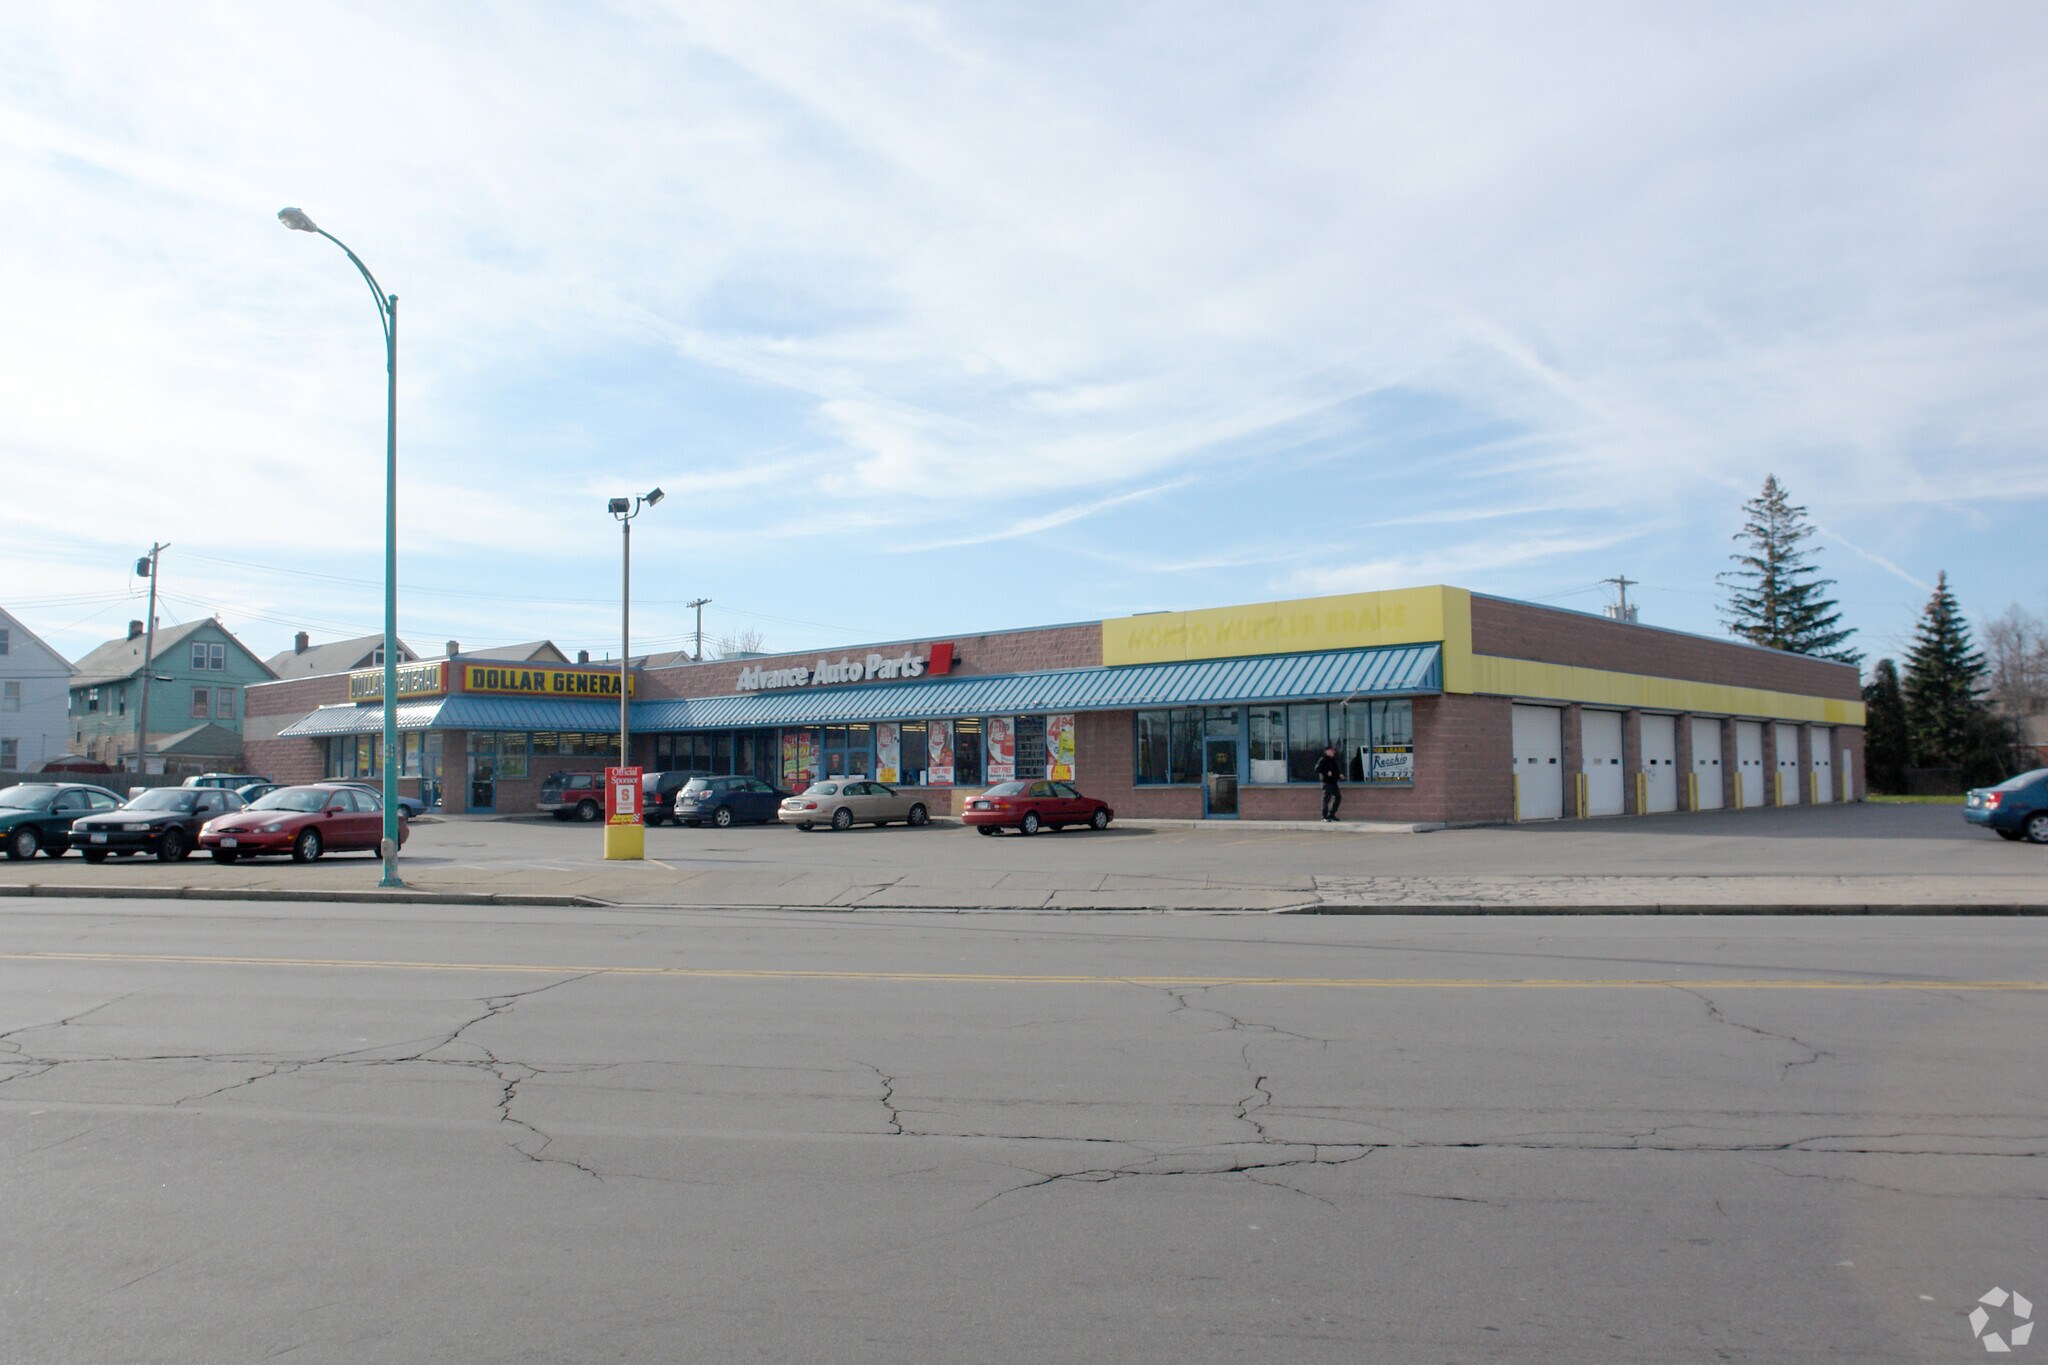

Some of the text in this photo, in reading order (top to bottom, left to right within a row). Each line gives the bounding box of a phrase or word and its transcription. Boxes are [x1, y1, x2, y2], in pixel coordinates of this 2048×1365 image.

[1326, 604, 1407, 633] BRAKE
[736, 651, 924, 690] Advance Auto Parts
[472, 668, 546, 691] DOLLAR
[612, 768, 638, 776] Official
[611, 777, 638, 785] Sponsor
[621, 789, 630, 801] S
